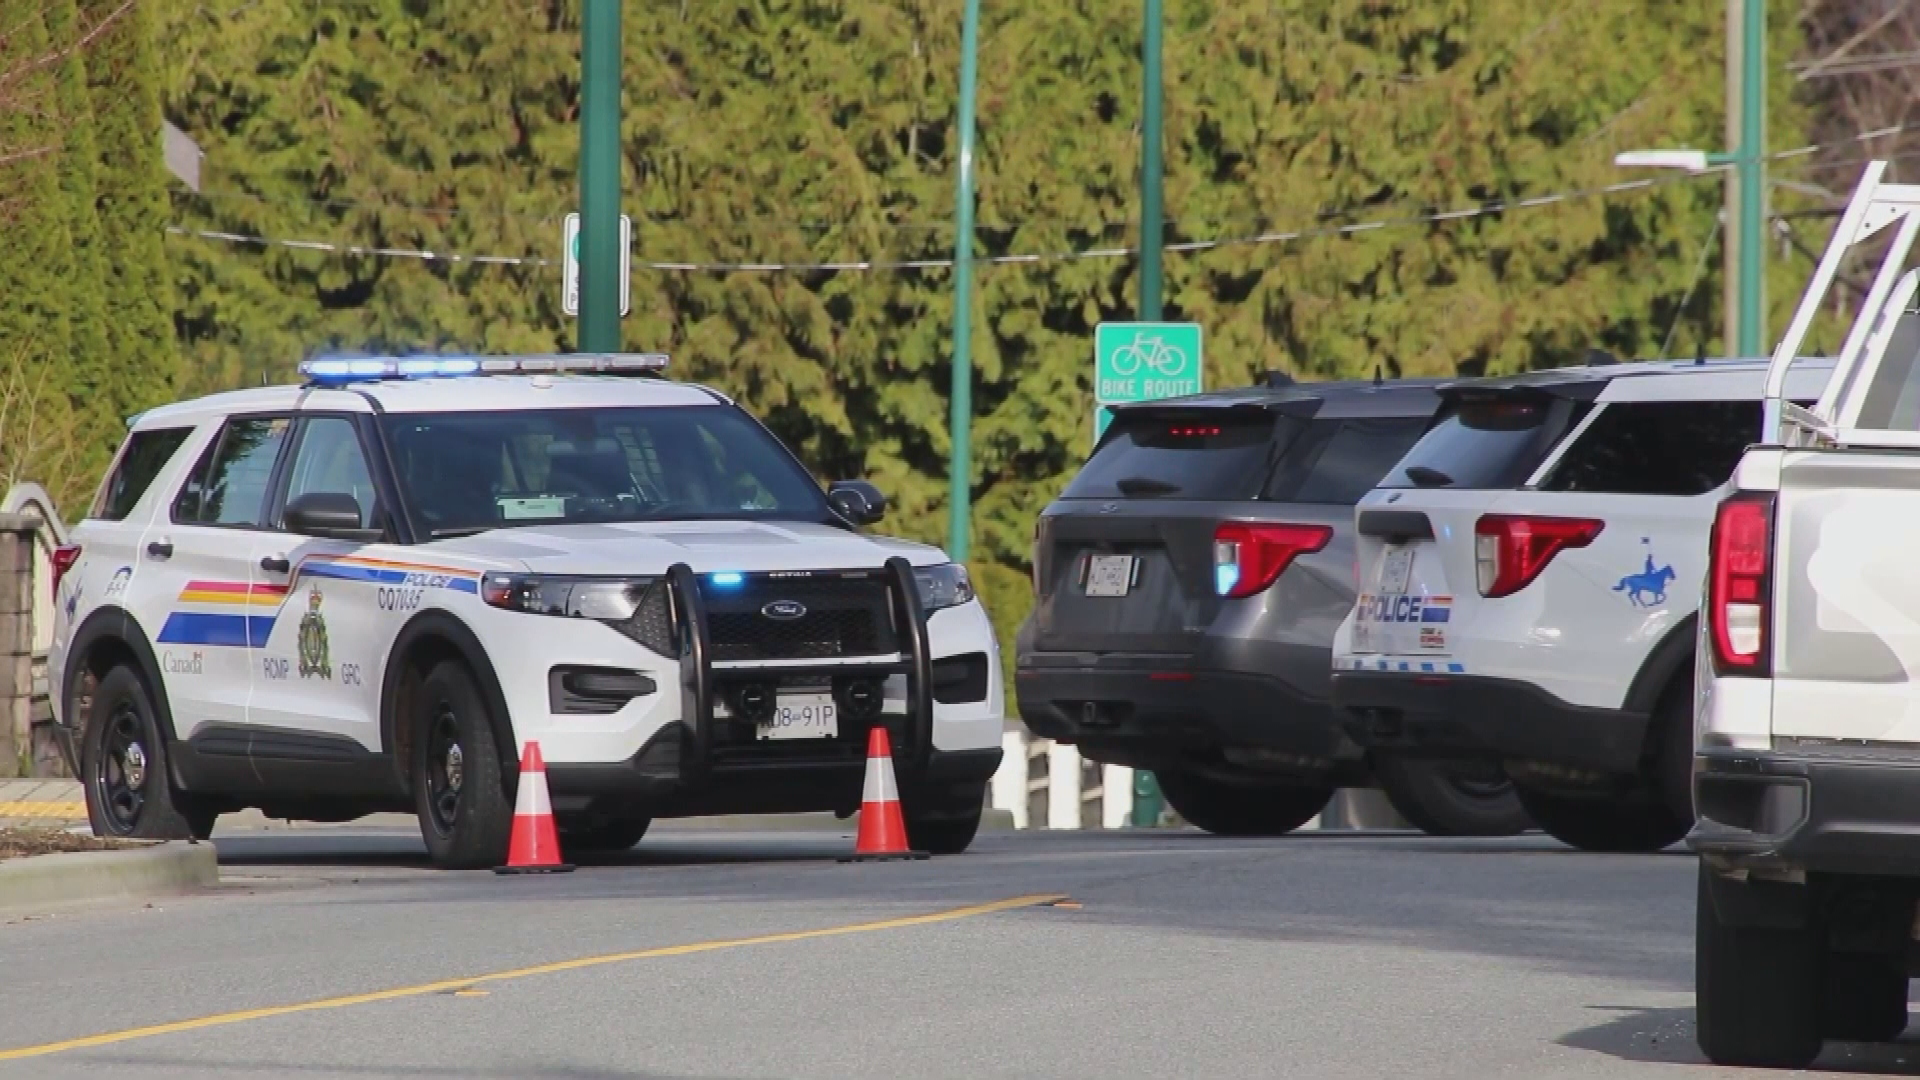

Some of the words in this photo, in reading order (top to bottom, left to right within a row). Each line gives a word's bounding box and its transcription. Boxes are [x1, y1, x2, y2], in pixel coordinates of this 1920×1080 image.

[1102, 379, 1136, 396] BIKE
[1144, 380, 1196, 399] ROUTE
[402, 572, 451, 590] POLICE
[1364, 595, 1422, 622] POLICE
[163, 650, 204, 674] Canada
[263, 657, 289, 679] RCMP
[341, 663, 361, 686] GRC
